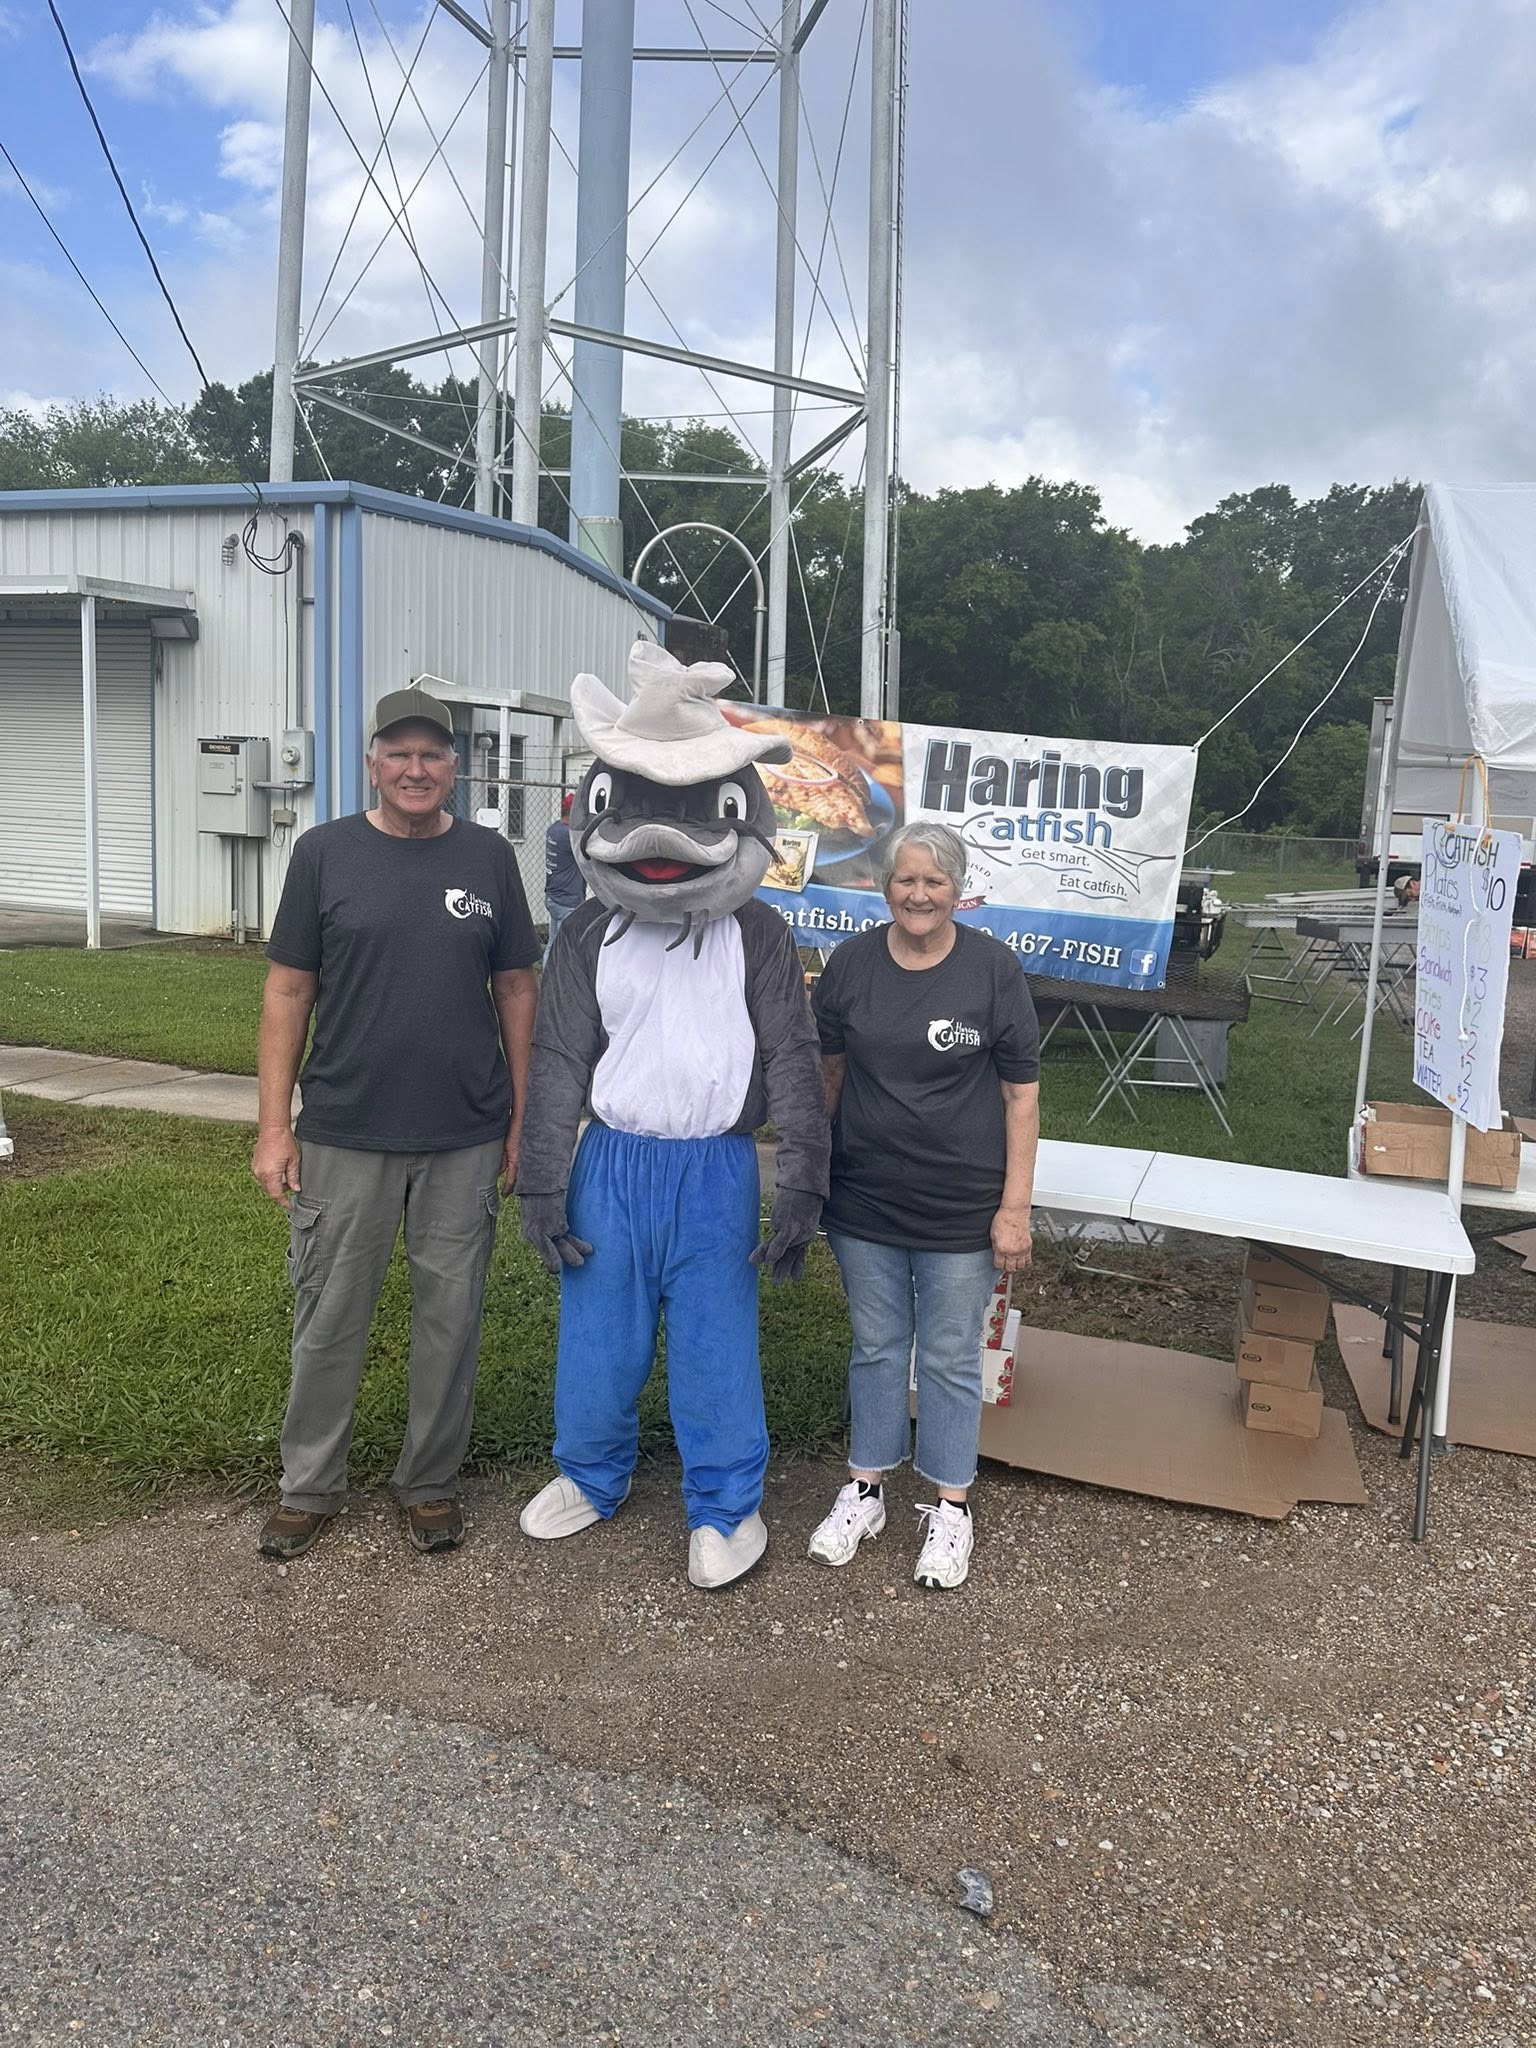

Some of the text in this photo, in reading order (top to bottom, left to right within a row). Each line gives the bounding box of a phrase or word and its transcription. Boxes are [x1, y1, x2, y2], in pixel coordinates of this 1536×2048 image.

[920, 738, 1144, 819] Haring
[1021, 848, 1090, 867] Get smart.
[1060, 874, 1128, 897] Eat catfish.
[1424, 853, 1459, 900] Plates
[458, 899, 493, 918] CATFISH
[1004, 931, 1122, 968] 467-FISH
[940, 1030, 980, 1046] CATFISH
[1416, 1032, 1434, 1064] TEA
[1416, 1060, 1442, 1097] WATER
